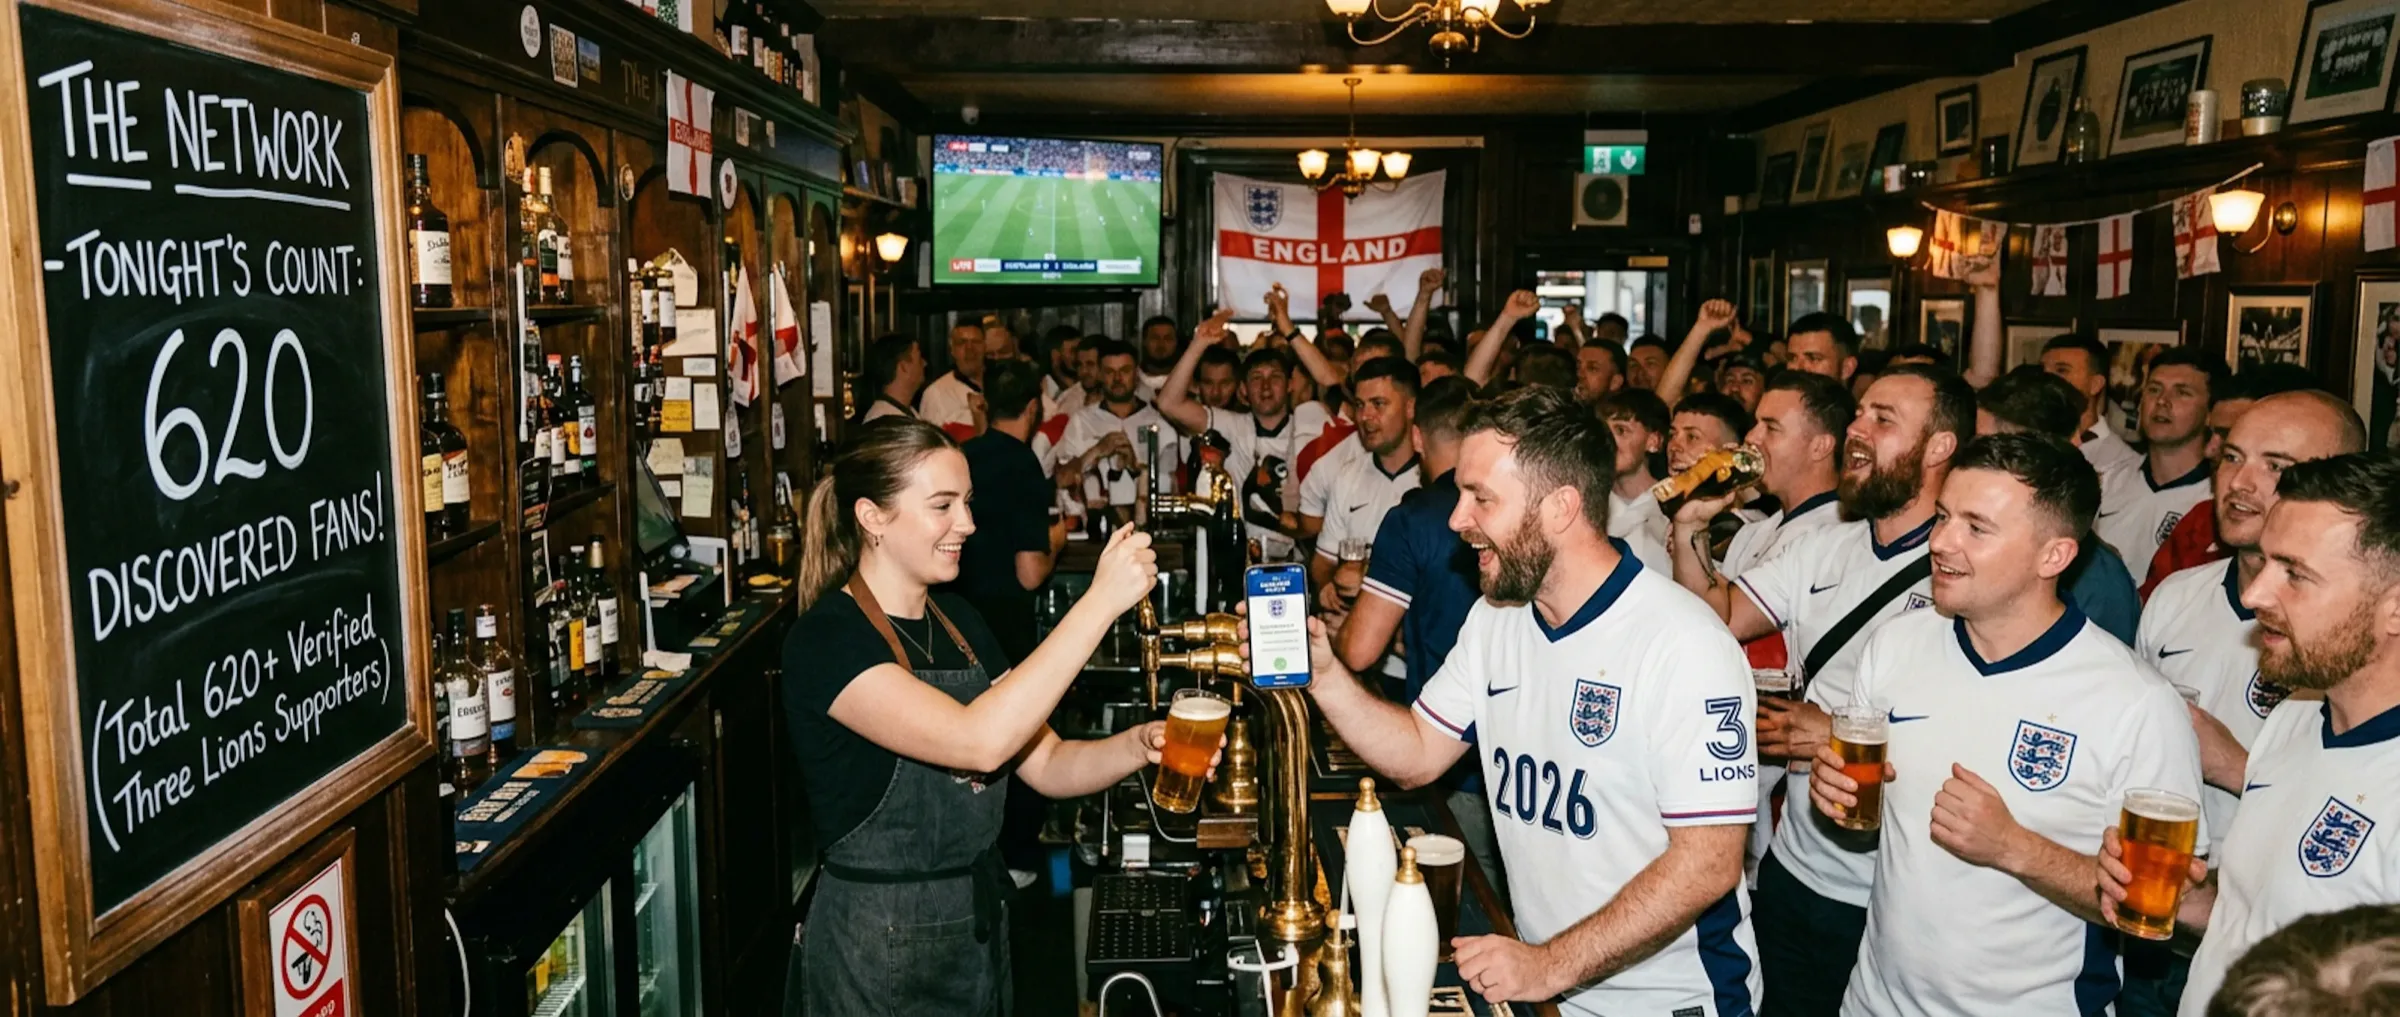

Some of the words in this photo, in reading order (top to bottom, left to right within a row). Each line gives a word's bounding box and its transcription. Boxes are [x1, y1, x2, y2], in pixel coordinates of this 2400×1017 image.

[39, 60, 148, 163] THE
[165, 87, 350, 190] NETWORK
[43, 229, 251, 305] -TONIGHT'S
[265, 241, 365, 297] COUNT:
[1252, 237, 1407, 264] ENGLAND
[144, 327, 313, 500] 620
[88, 516, 297, 641] DISCOVERED
[310, 470, 386, 561] FANS!
[204, 648, 280, 718] 620+
[287, 593, 376, 673] Verified
[113, 766, 194, 834] Three
[202, 722, 267, 785] Lions
[275, 637, 391, 743] Supporters)
[1699, 764, 1757, 782] LIONS
[1704, 696, 1749, 761] 3
[1493, 746, 1599, 840] 2026
